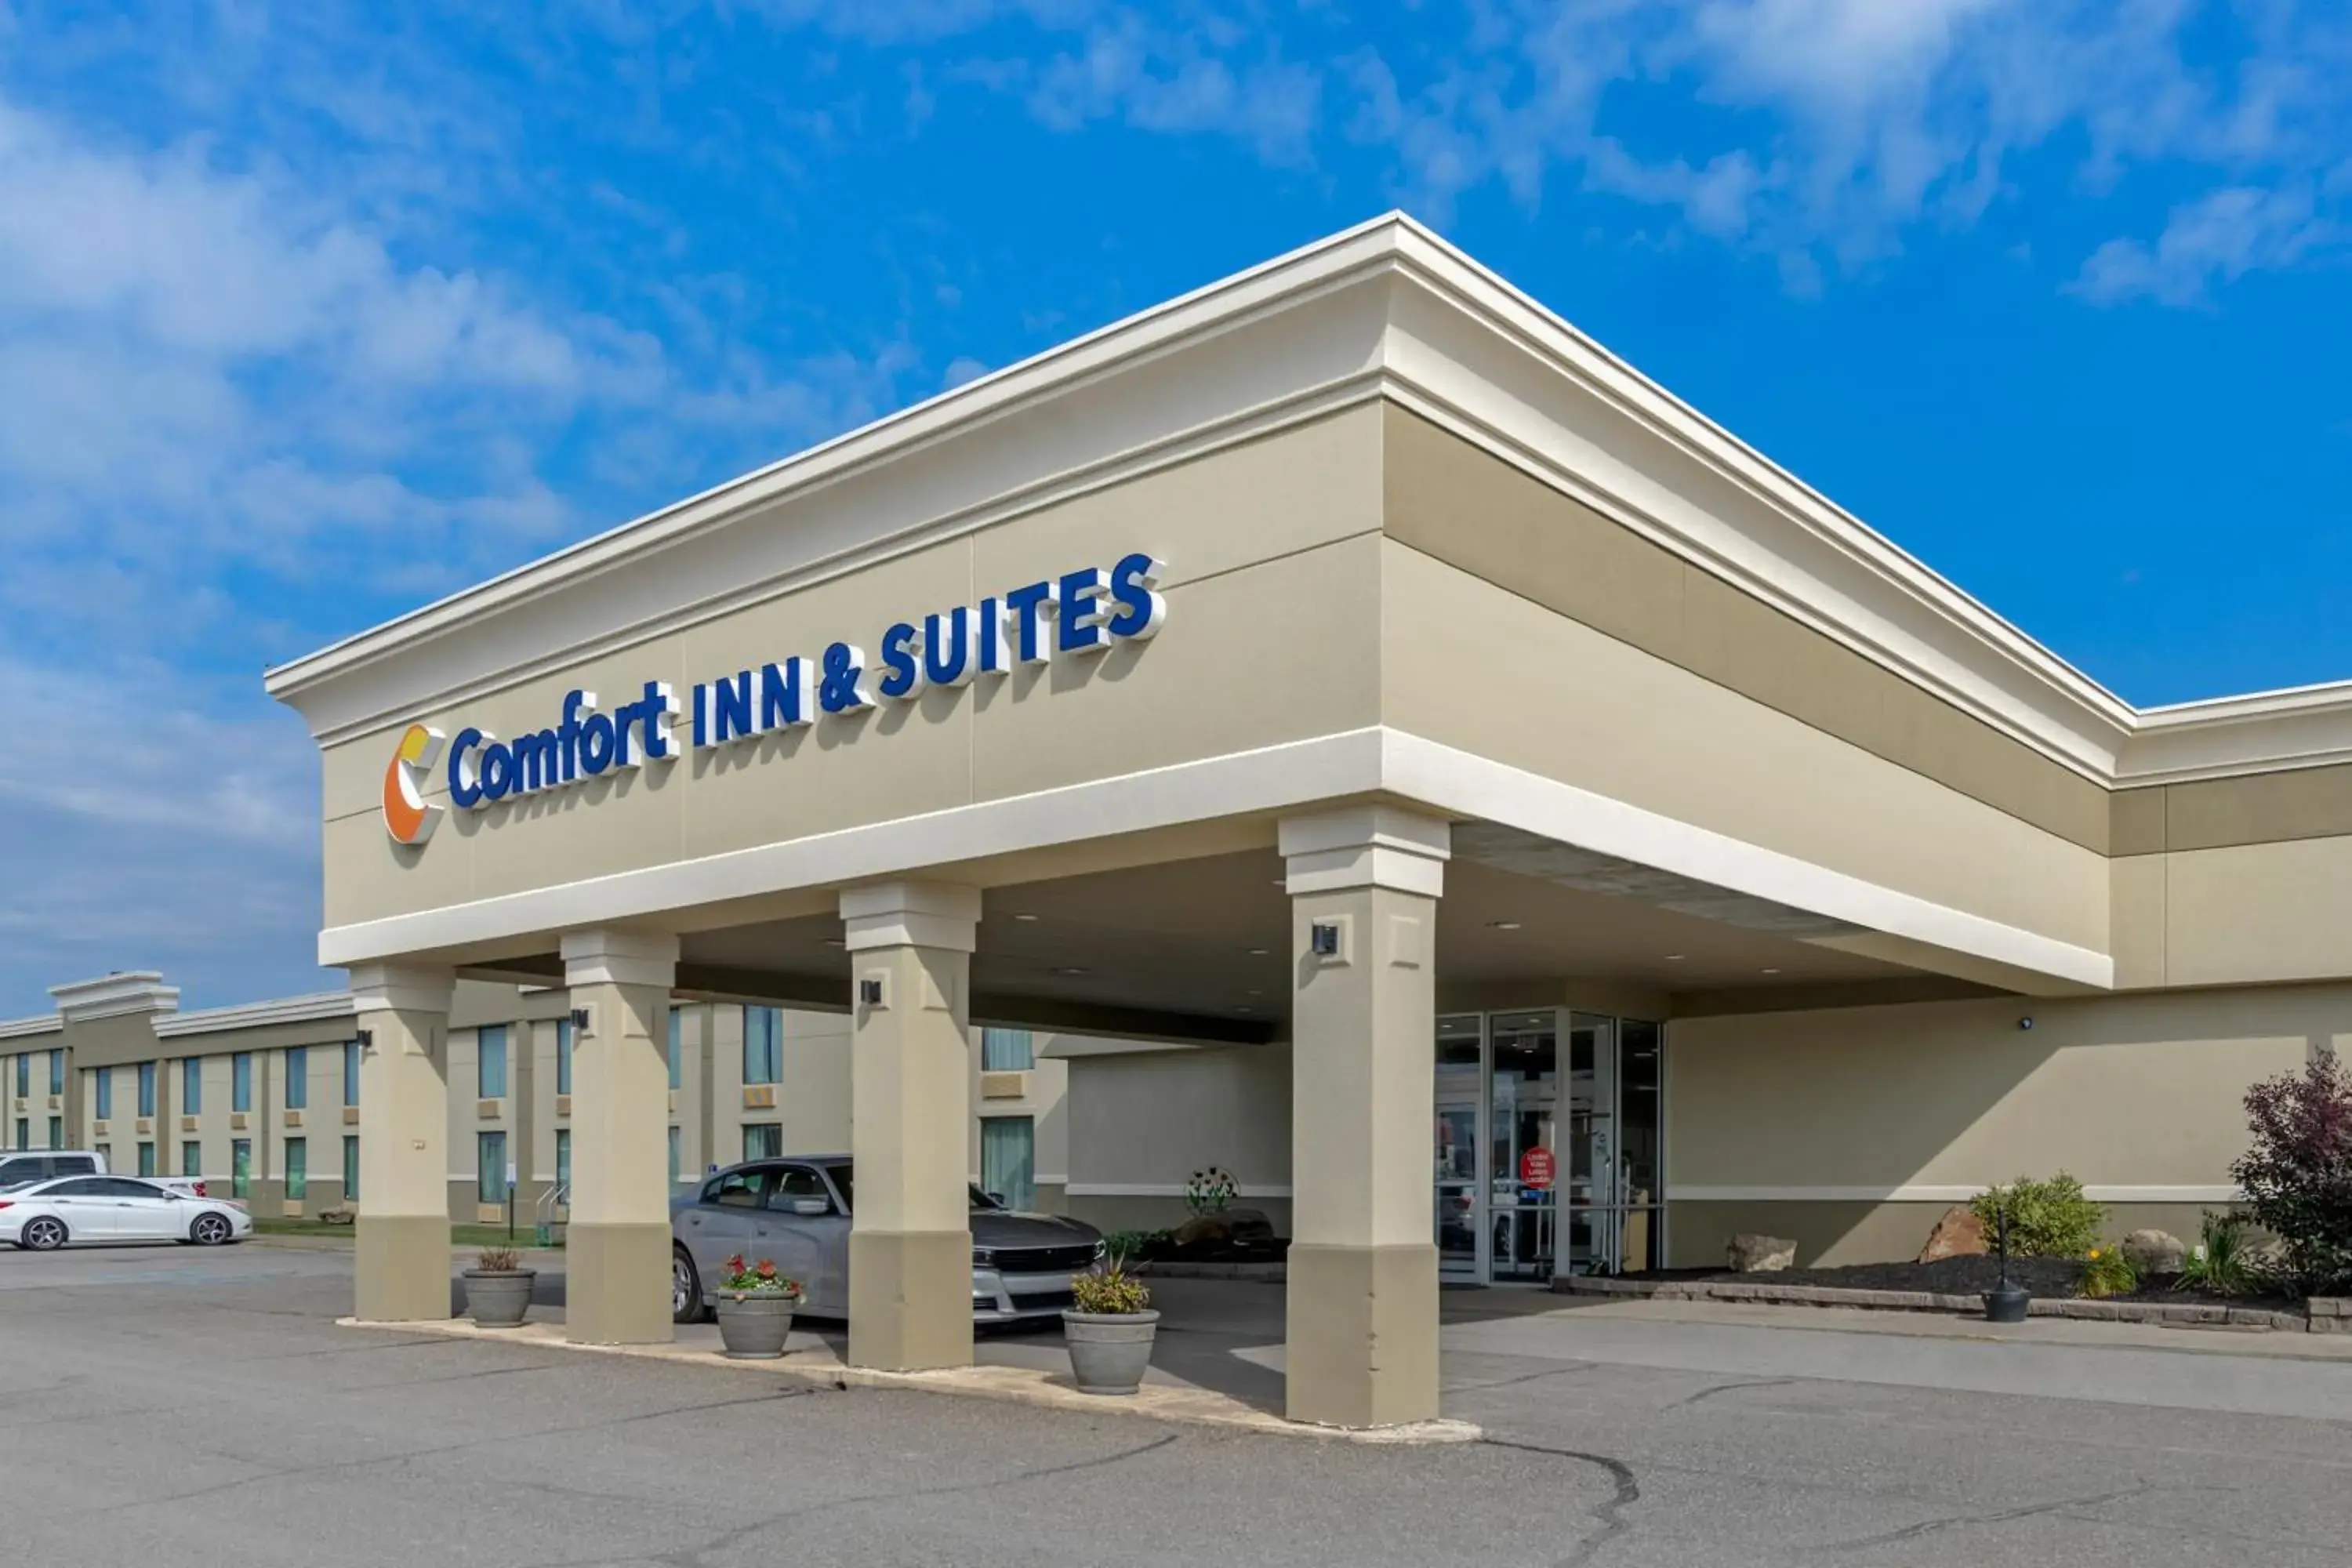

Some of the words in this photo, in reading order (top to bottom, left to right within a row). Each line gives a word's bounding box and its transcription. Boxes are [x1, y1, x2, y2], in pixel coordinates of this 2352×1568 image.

[448, 681, 670, 808] Comfort
[693, 656, 803, 747] INN
[819, 641, 862, 713] &
[879, 553, 1155, 698] SUITES
